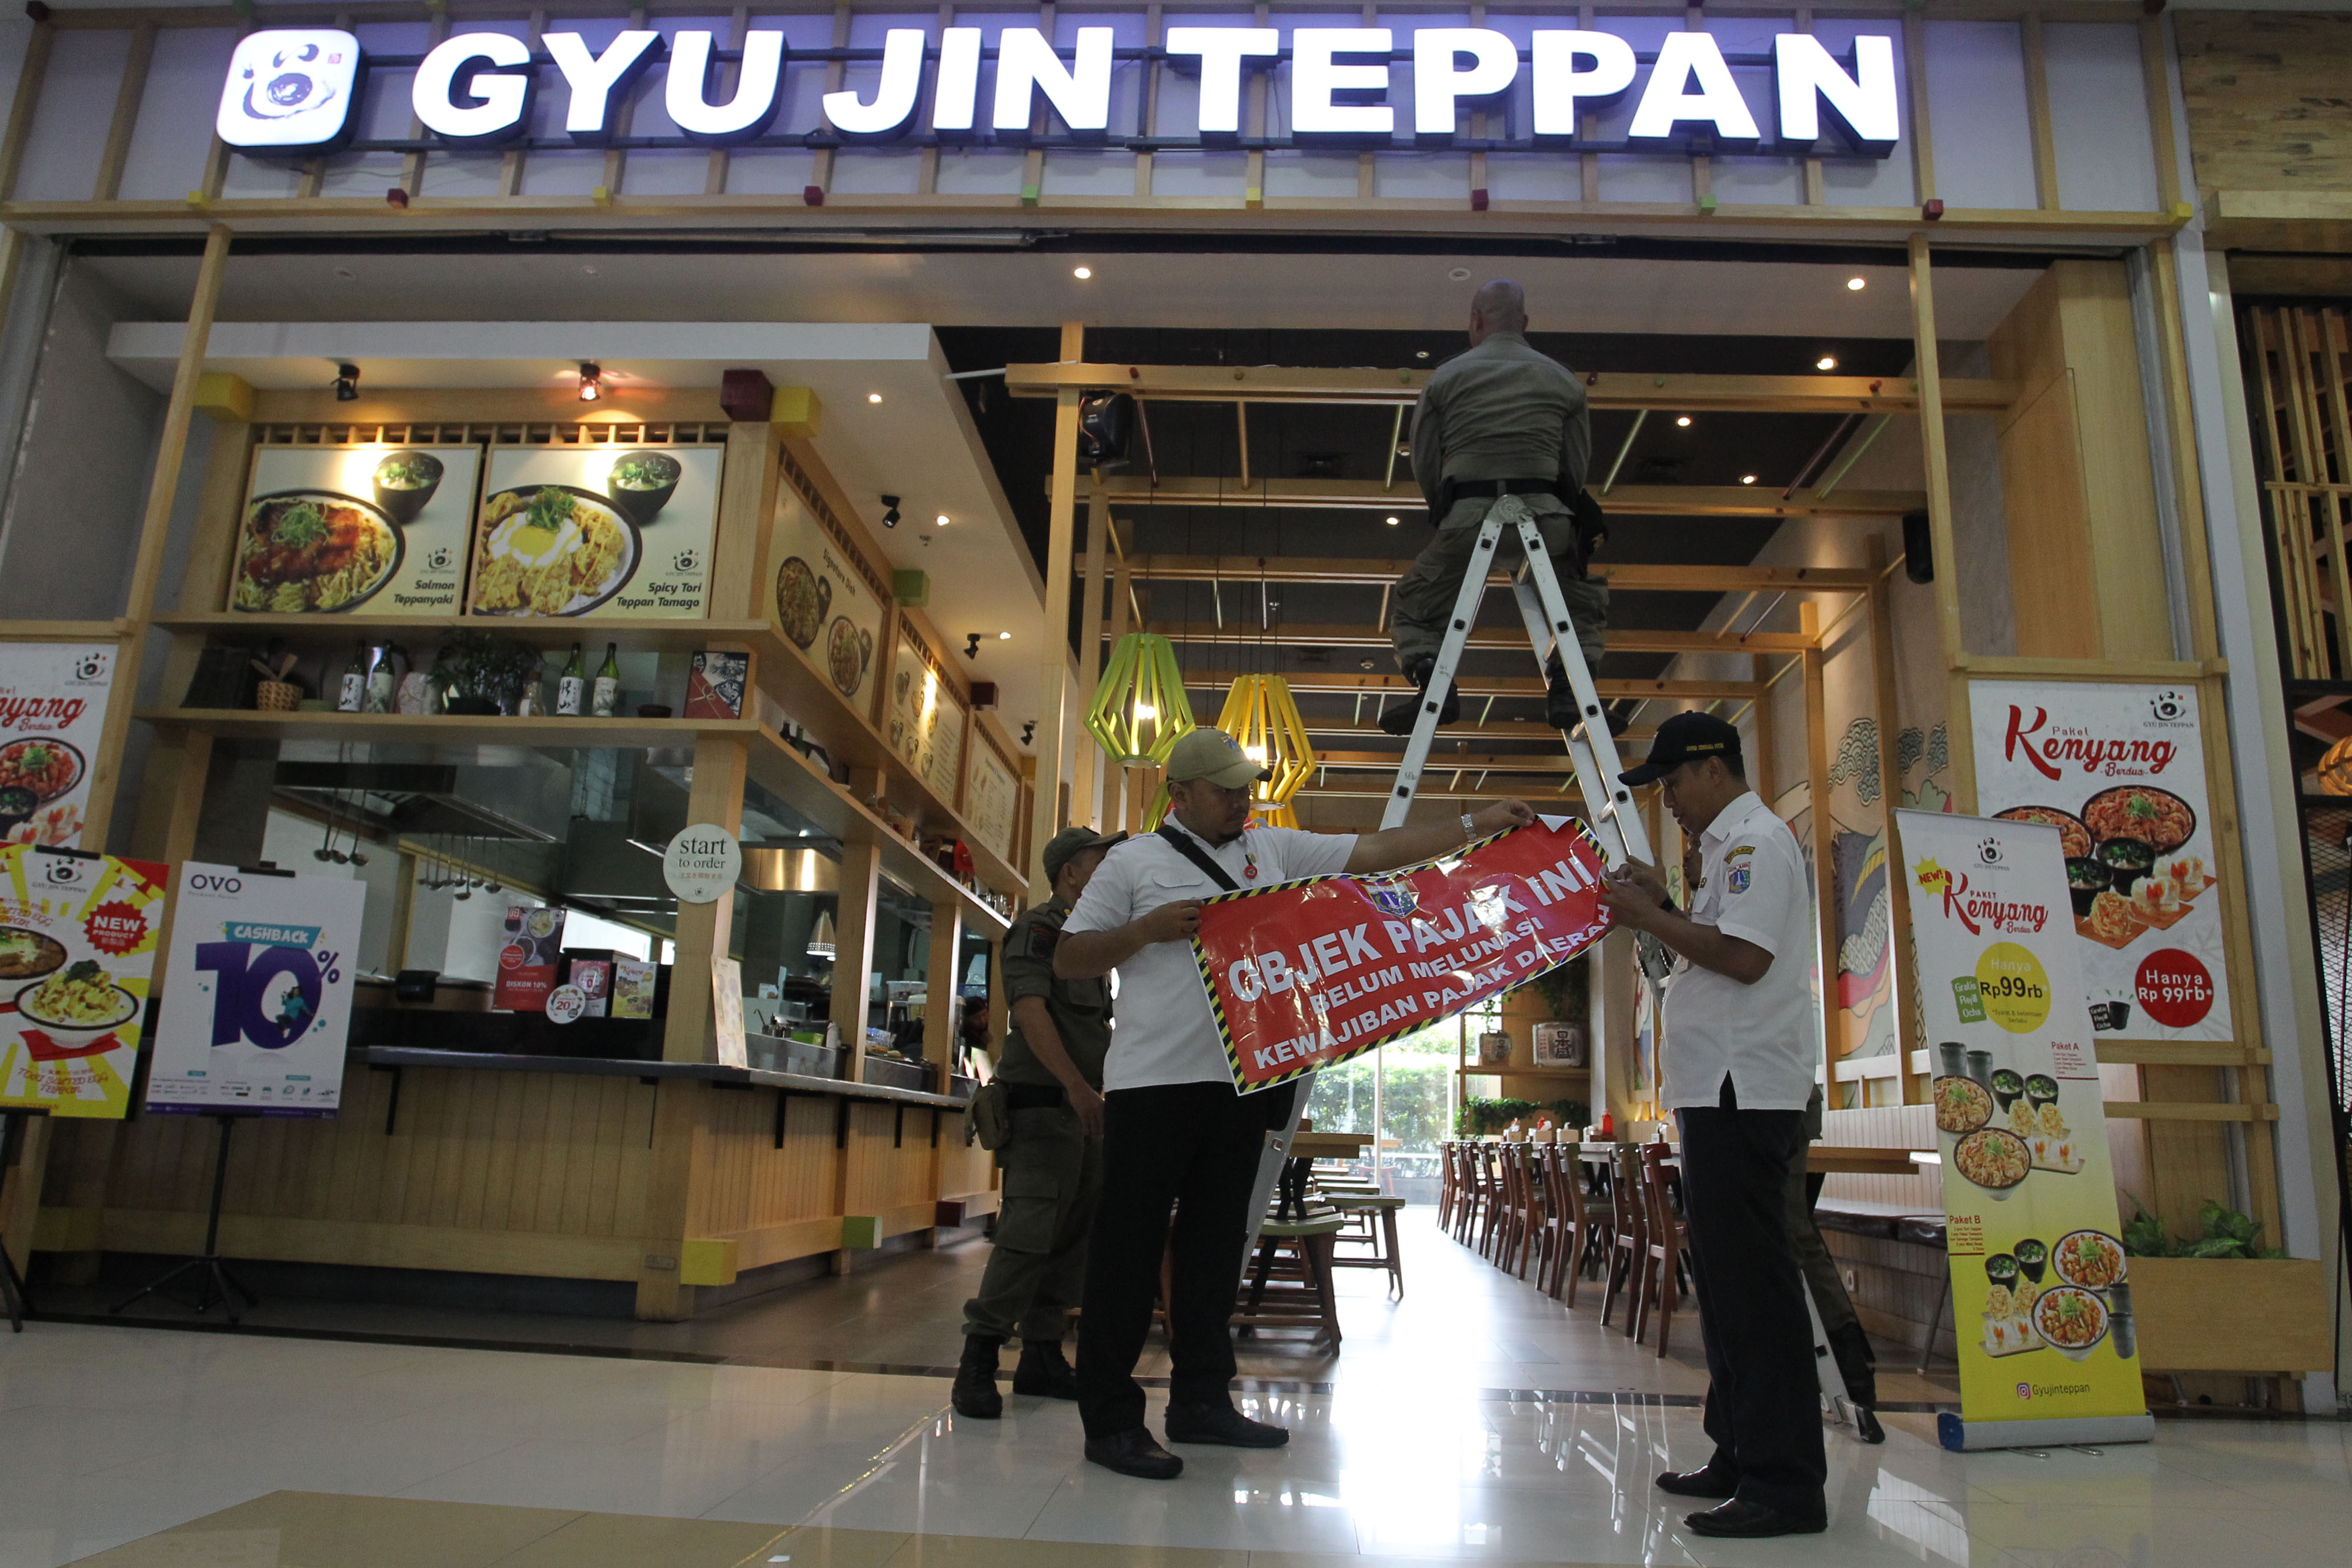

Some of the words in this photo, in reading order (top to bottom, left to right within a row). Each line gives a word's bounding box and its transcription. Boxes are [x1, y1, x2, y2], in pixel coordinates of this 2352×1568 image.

[412, 28, 786, 139] GYU
[822, 26, 1115, 136] JIN
[1165, 26, 1899, 142] TEPPAN
[823, 549, 845, 583] Signature
[414, 579, 455, 589] Salmon
[648, 582, 678, 595] Spicy
[681, 583, 702, 593] Tori
[394, 594, 454, 607] Teppanyaki
[617, 597, 654, 609] Teppan
[658, 597, 700, 610] Tamago
[2052, 726, 2089, 736] Paket
[2005, 704, 2177, 781] Kenyang
[680, 837, 727, 855] start
[679, 858, 690, 868] to
[694, 857, 726, 869] order
[191, 874, 242, 893] OVO
[1918, 869, 1943, 884] NEW!
[1970, 890, 1997, 900] PAKET
[1943, 870, 2049, 936] Kenyang
[93, 915, 141, 932] NEW
[1228, 922, 1382, 1002] OBJEK
[1382, 884, 1528, 954] PAJAK
[1525, 855, 1595, 907] INI
[92, 930, 135, 939] PRODUCT
[233, 925, 309, 944] CASHBACK
[1309, 965, 1404, 1014] BELUM
[1408, 917, 1544, 979] MELUNASI
[1991, 958, 2032, 974] Hanya
[2145, 969, 2203, 988] Hanya
[1253, 995, 1419, 1069] KEWAJIBAN
[1422, 961, 1514, 1008] PAJAK
[1515, 904, 1610, 968] DAERAH
[1955, 981, 1977, 992] Gratis
[194, 942, 340, 1049] 10%
[2138, 987, 2158, 1002] Rp
[1962, 1008, 1982, 1018] Ocha
[2051, 1041, 2072, 1051] Paket
[2073, 1042, 2080, 1051] A
[1949, 1214, 1972, 1224] Paket
[1974, 1215, 1981, 1224] B
[2032, 1384, 2090, 1397] Gyujinteppan
